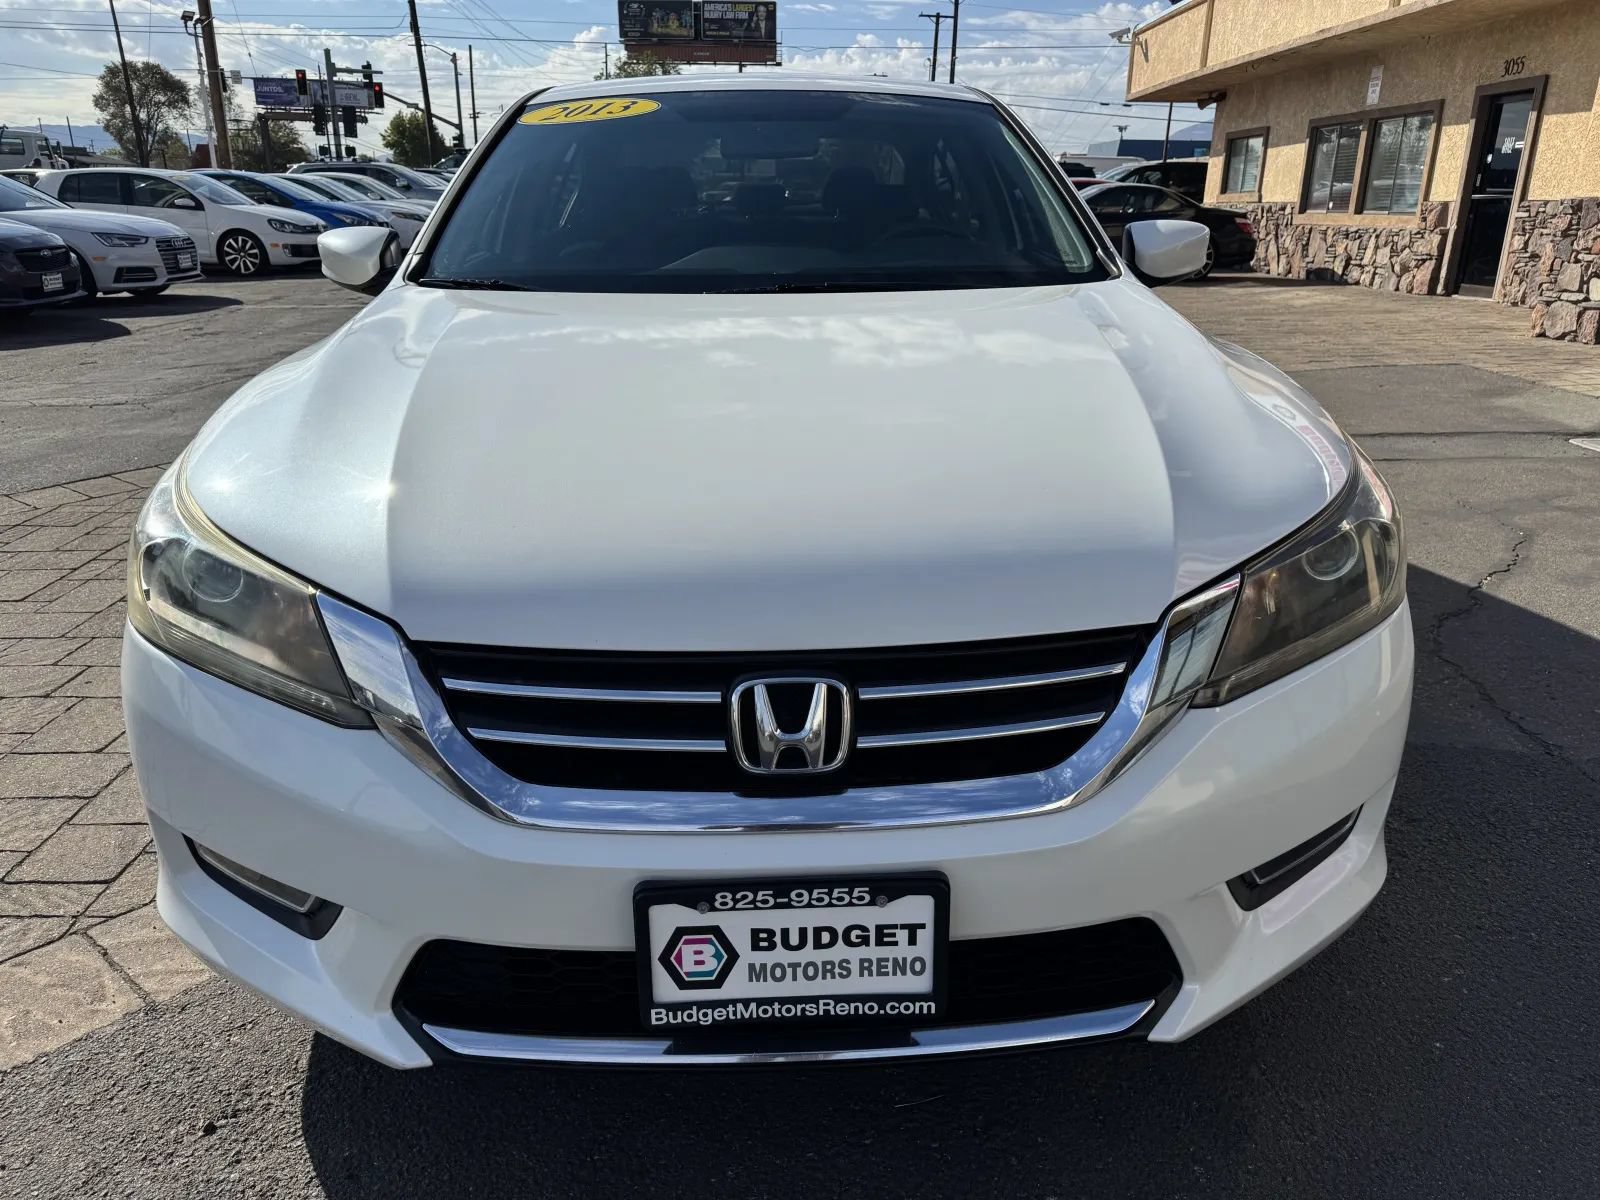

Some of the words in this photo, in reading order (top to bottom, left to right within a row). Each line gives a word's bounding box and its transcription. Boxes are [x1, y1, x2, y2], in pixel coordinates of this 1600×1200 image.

[723, 11, 734, 19] LAW
[1501, 56, 1526, 77] 3055
[538, 101, 638, 122] 2013
[714, 887, 871, 910] 825-9555
[750, 923, 926, 952] BUDGET
[681, 943, 719, 973] B
[748, 958, 852, 983] MOTORS
[858, 956, 927, 978] RENO
[650, 999, 936, 1026] BudgetMotorsReno.com
